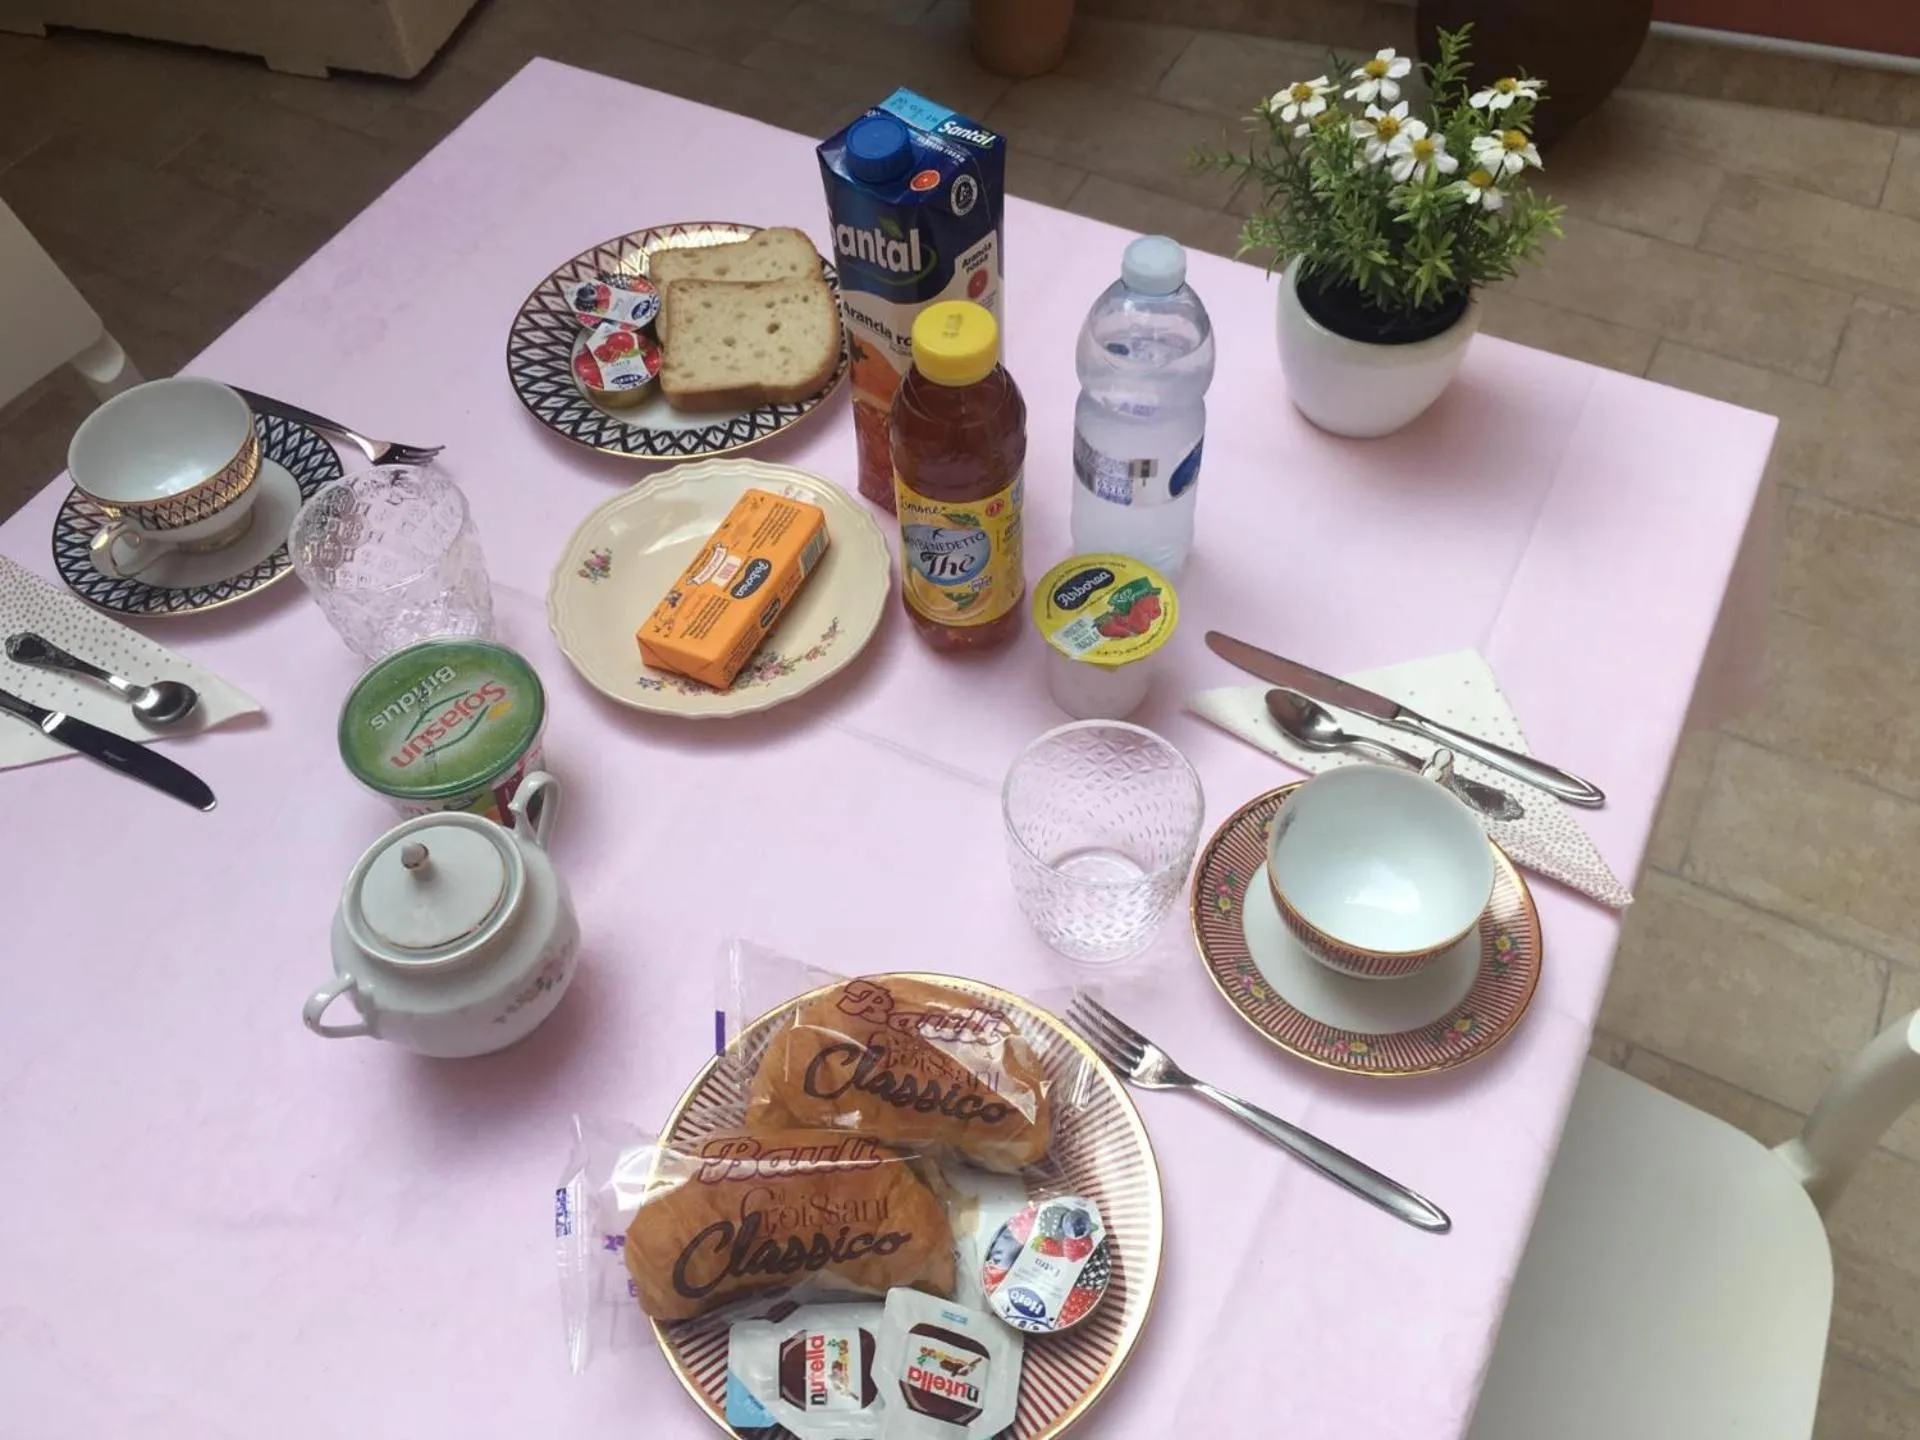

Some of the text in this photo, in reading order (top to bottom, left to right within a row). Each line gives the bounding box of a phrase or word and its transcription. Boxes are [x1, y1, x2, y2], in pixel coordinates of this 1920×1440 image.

[938, 121, 996, 145] Santal
[831, 223, 922, 272] antal
[842, 301, 893, 341] Arancia
[1057, 571, 1111, 606] Arborea
[370, 666, 456, 730] Bifidus
[390, 680, 506, 768] Sojasun
[803, 1042, 1010, 1123] Classico
[672, 1210, 912, 1298] Classico
[1010, 1290, 1043, 1315] Hero
[805, 1334, 826, 1405] nutella
[908, 1365, 980, 1402] nutella
